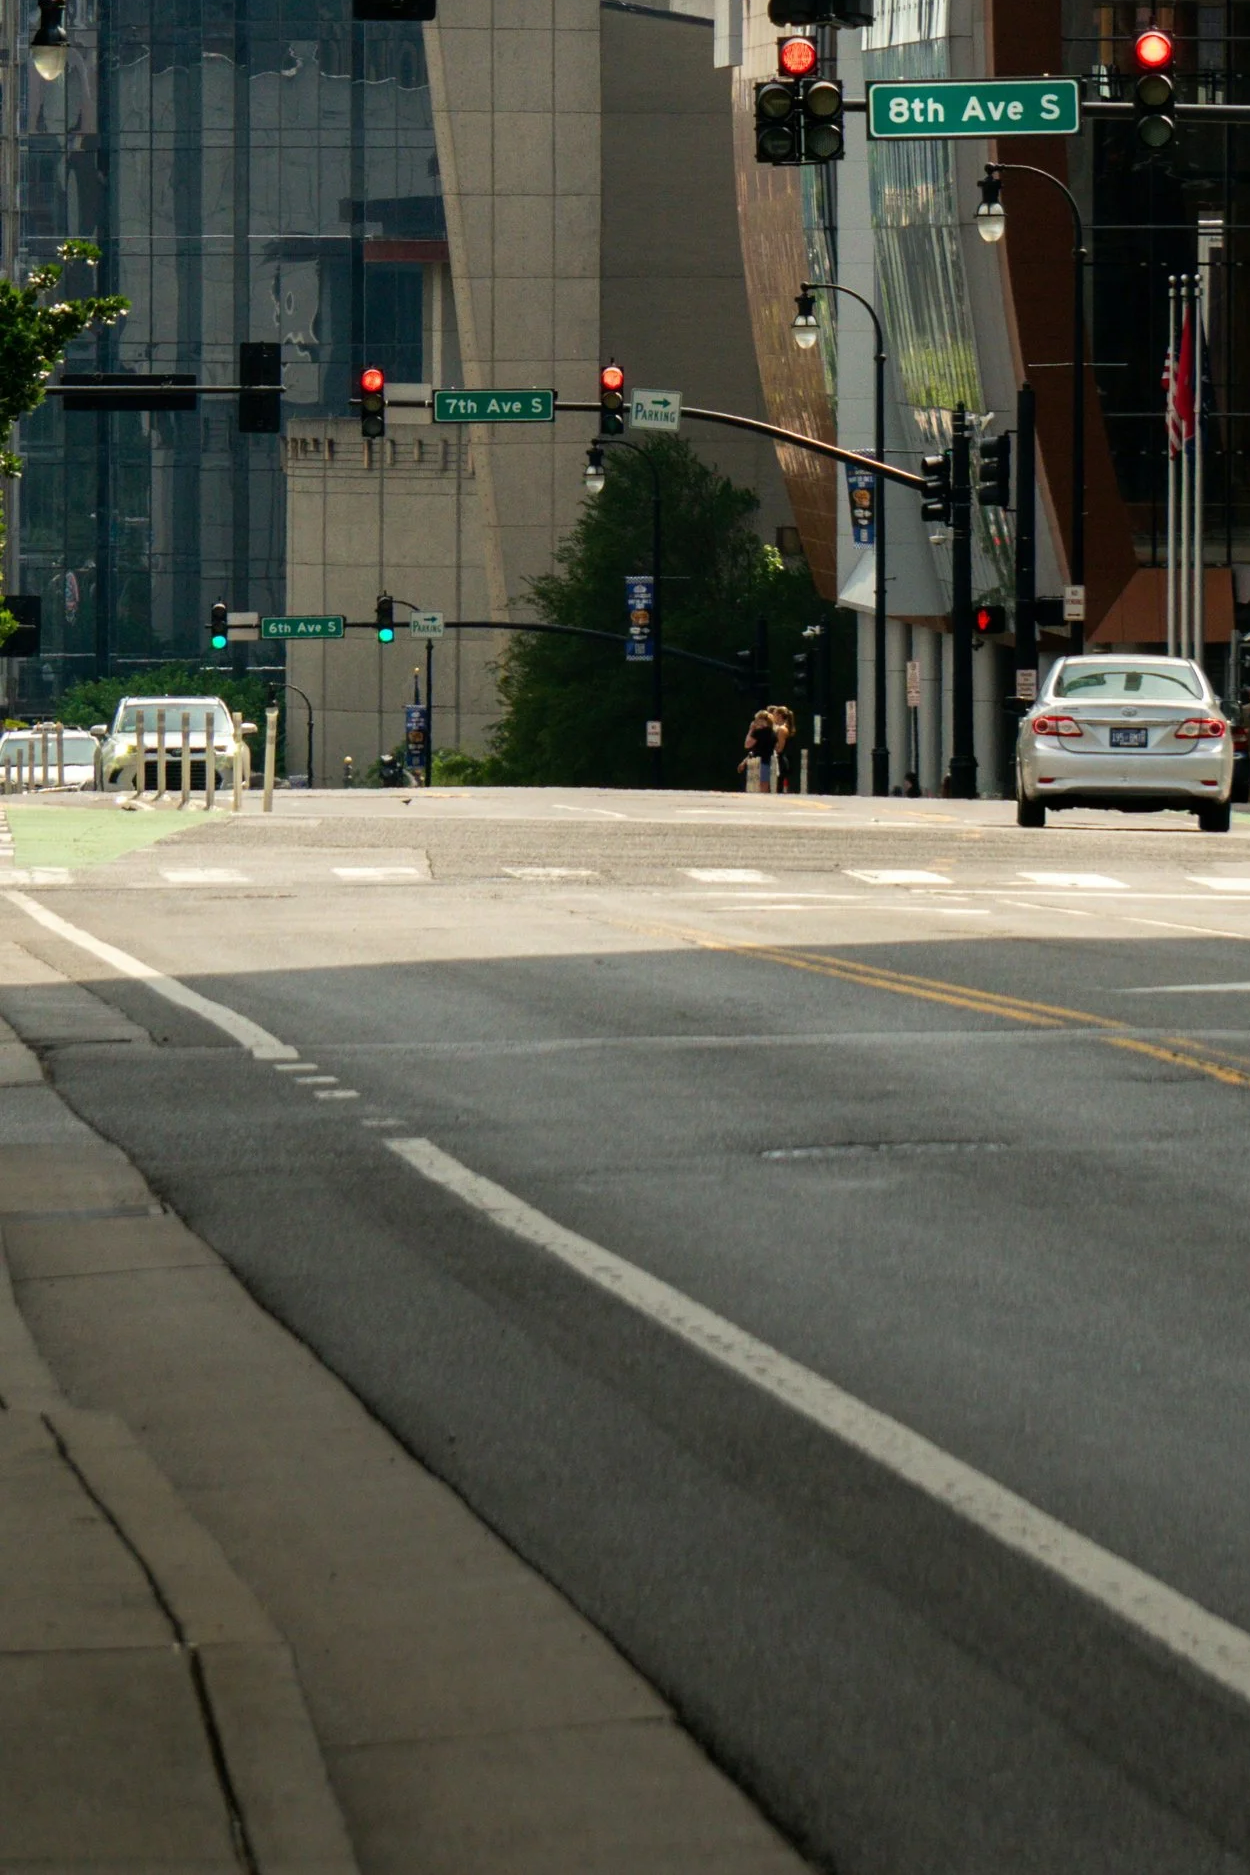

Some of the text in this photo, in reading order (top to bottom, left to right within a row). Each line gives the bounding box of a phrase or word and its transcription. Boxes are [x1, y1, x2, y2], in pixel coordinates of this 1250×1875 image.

[889, 94, 1061, 123] 8th Ave S
[445, 397, 543, 414] 7th Ave S
[635, 404, 676, 423] PARKING
[268, 621, 337, 634] 6th Ave S
[412, 620, 443, 633] PARKING
